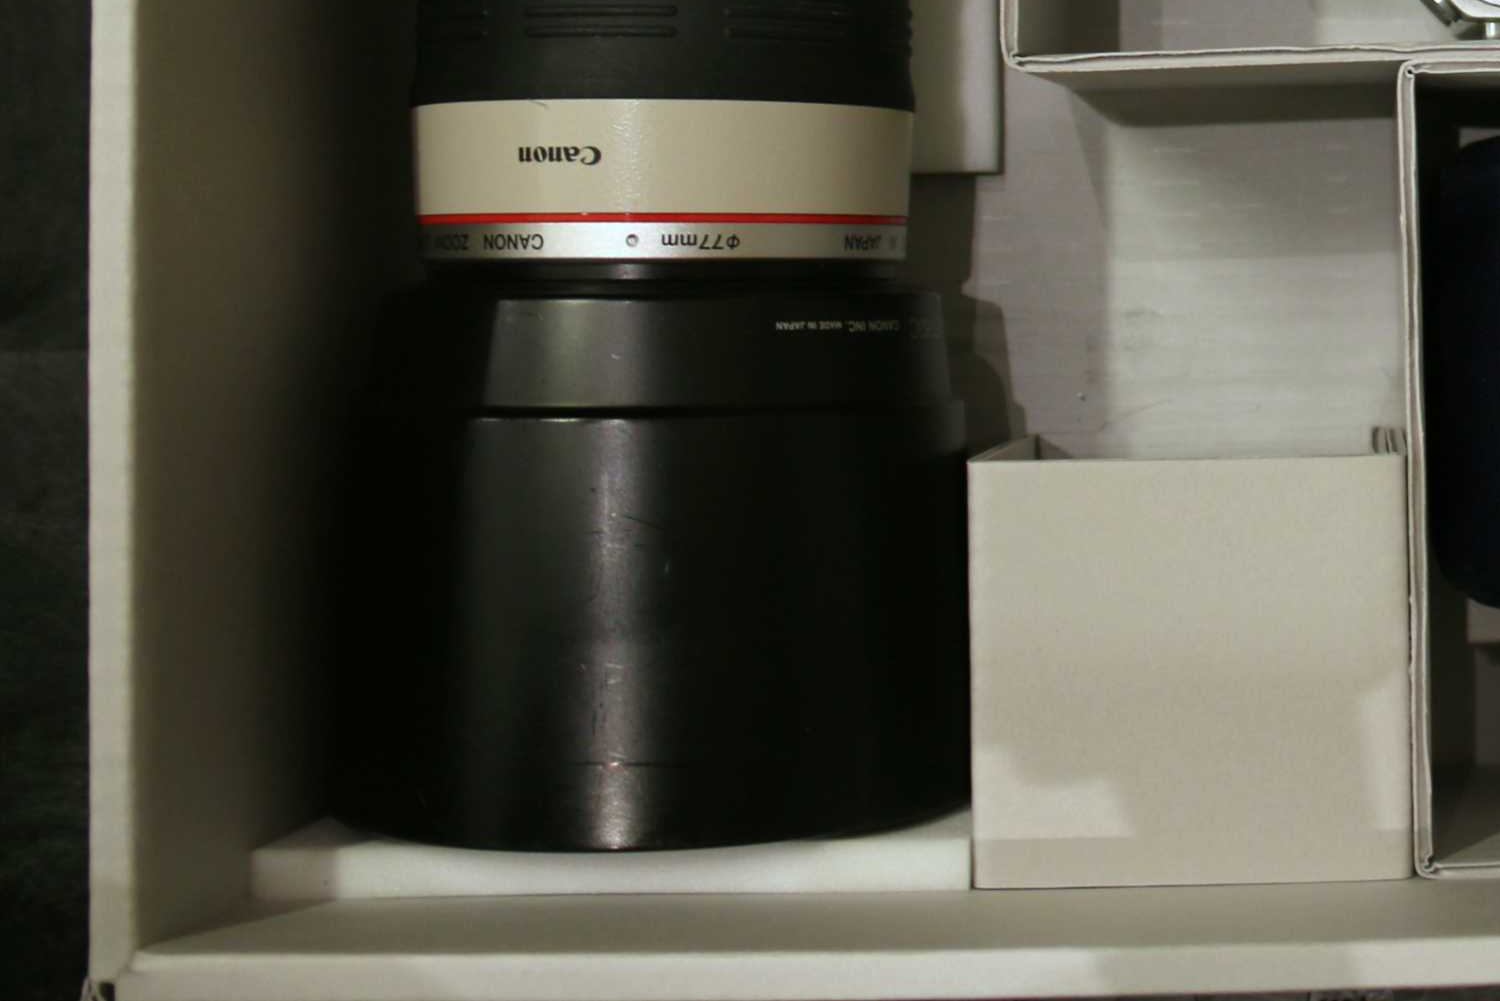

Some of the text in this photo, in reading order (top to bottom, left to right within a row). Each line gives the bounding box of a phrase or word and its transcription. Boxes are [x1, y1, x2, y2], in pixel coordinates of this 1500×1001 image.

[518, 146, 602, 166] Canon
[483, 233, 544, 250] CANON
[844, 234, 882, 250] JAPAN
[776, 320, 804, 331] JAPAN
